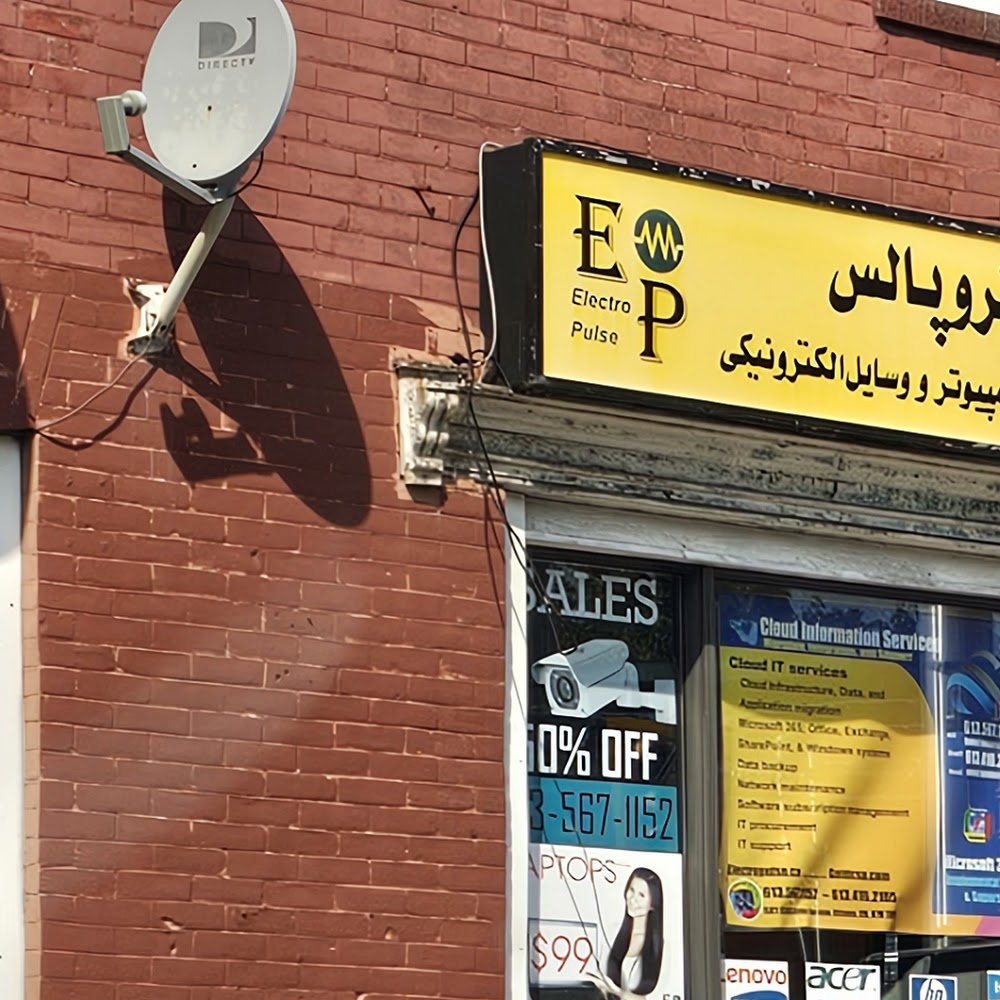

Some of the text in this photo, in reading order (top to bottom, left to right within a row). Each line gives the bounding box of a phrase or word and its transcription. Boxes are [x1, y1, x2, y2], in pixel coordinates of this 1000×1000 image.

[198, 57, 255, 70] DIRECTV
[571, 288, 631, 314] Electro
[571, 322, 619, 346] Pulse
[914, 373, 928, 403] و
[760, 616, 798, 636] Cloud
[801, 620, 881, 647] Information
[729, 656, 848, 678] Cloud IT services
[601, 729, 659, 780] OFF
[531, 931, 594, 974] $99
[724, 967, 786, 985] enovo
[808, 966, 876, 991] acer
